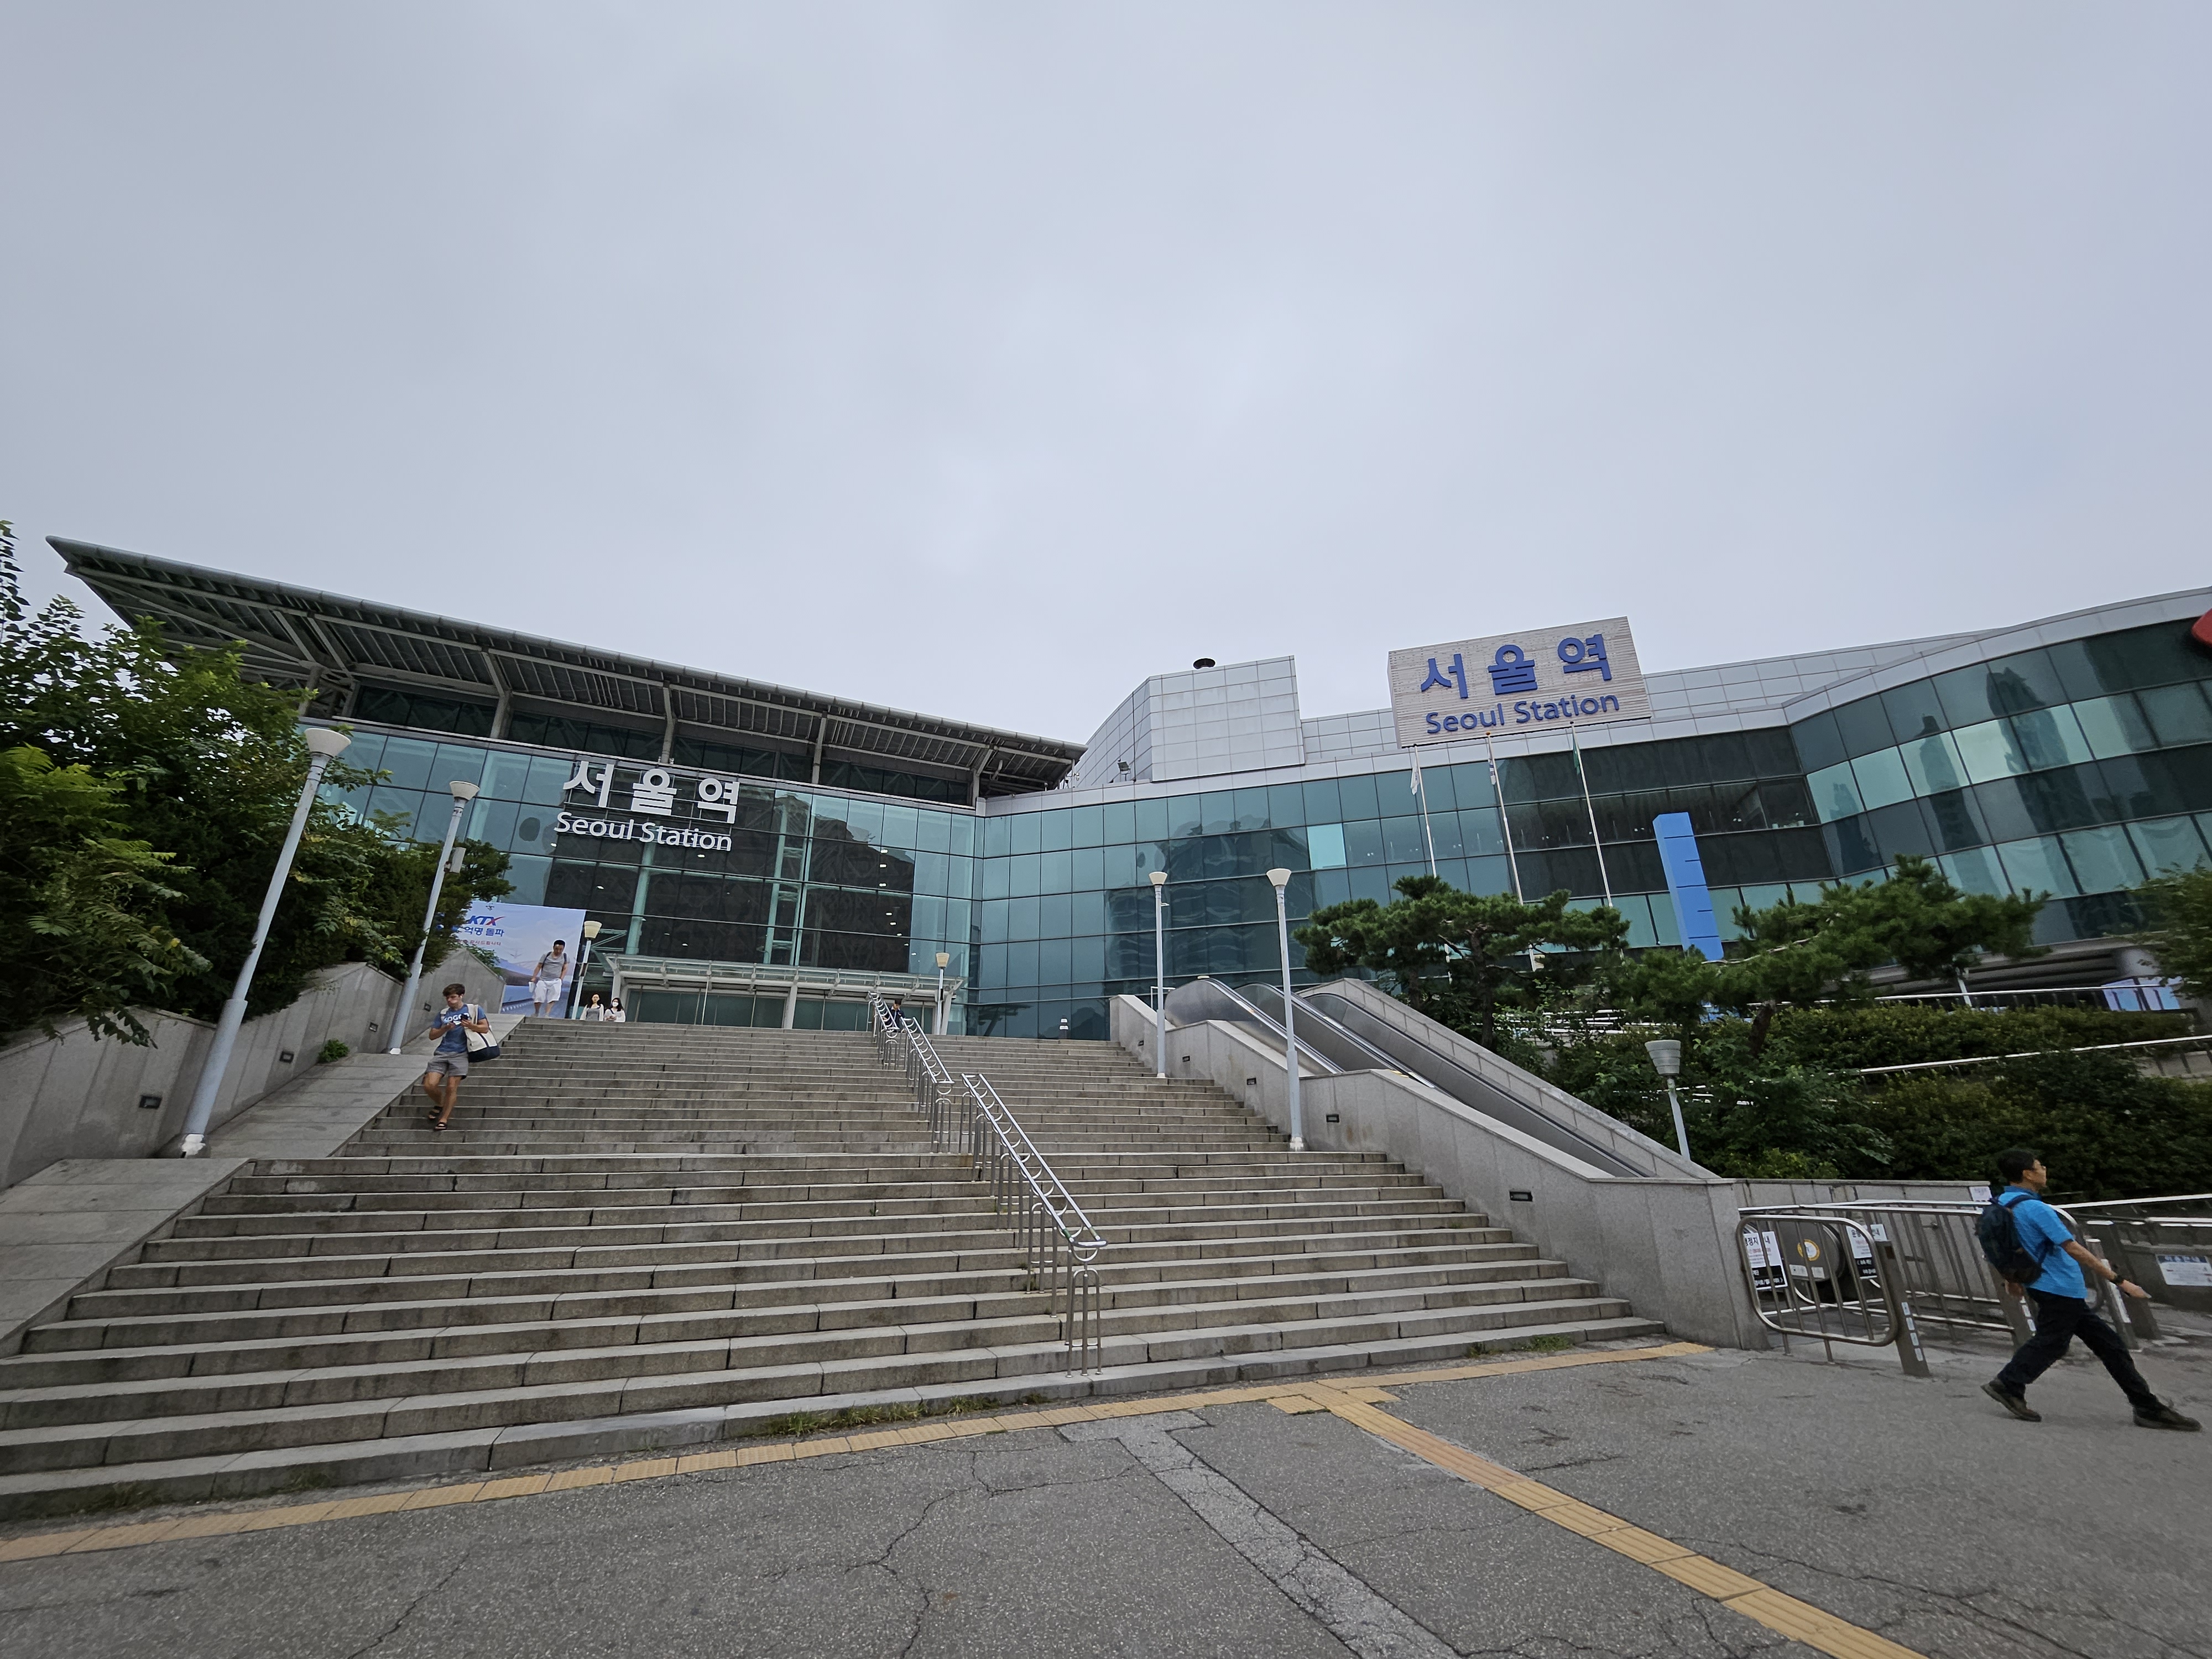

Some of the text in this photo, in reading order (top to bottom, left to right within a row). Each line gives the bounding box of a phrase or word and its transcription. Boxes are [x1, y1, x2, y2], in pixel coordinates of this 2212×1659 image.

[1421, 634, 1612, 698] 서울역
[1426, 694, 1620, 734] Seoul Station
[563, 761, 740, 824] 서울역
[554, 812, 732, 852] Seoul Station
[468, 915, 505, 926] KTX
[486, 928, 505, 937] 돌파
